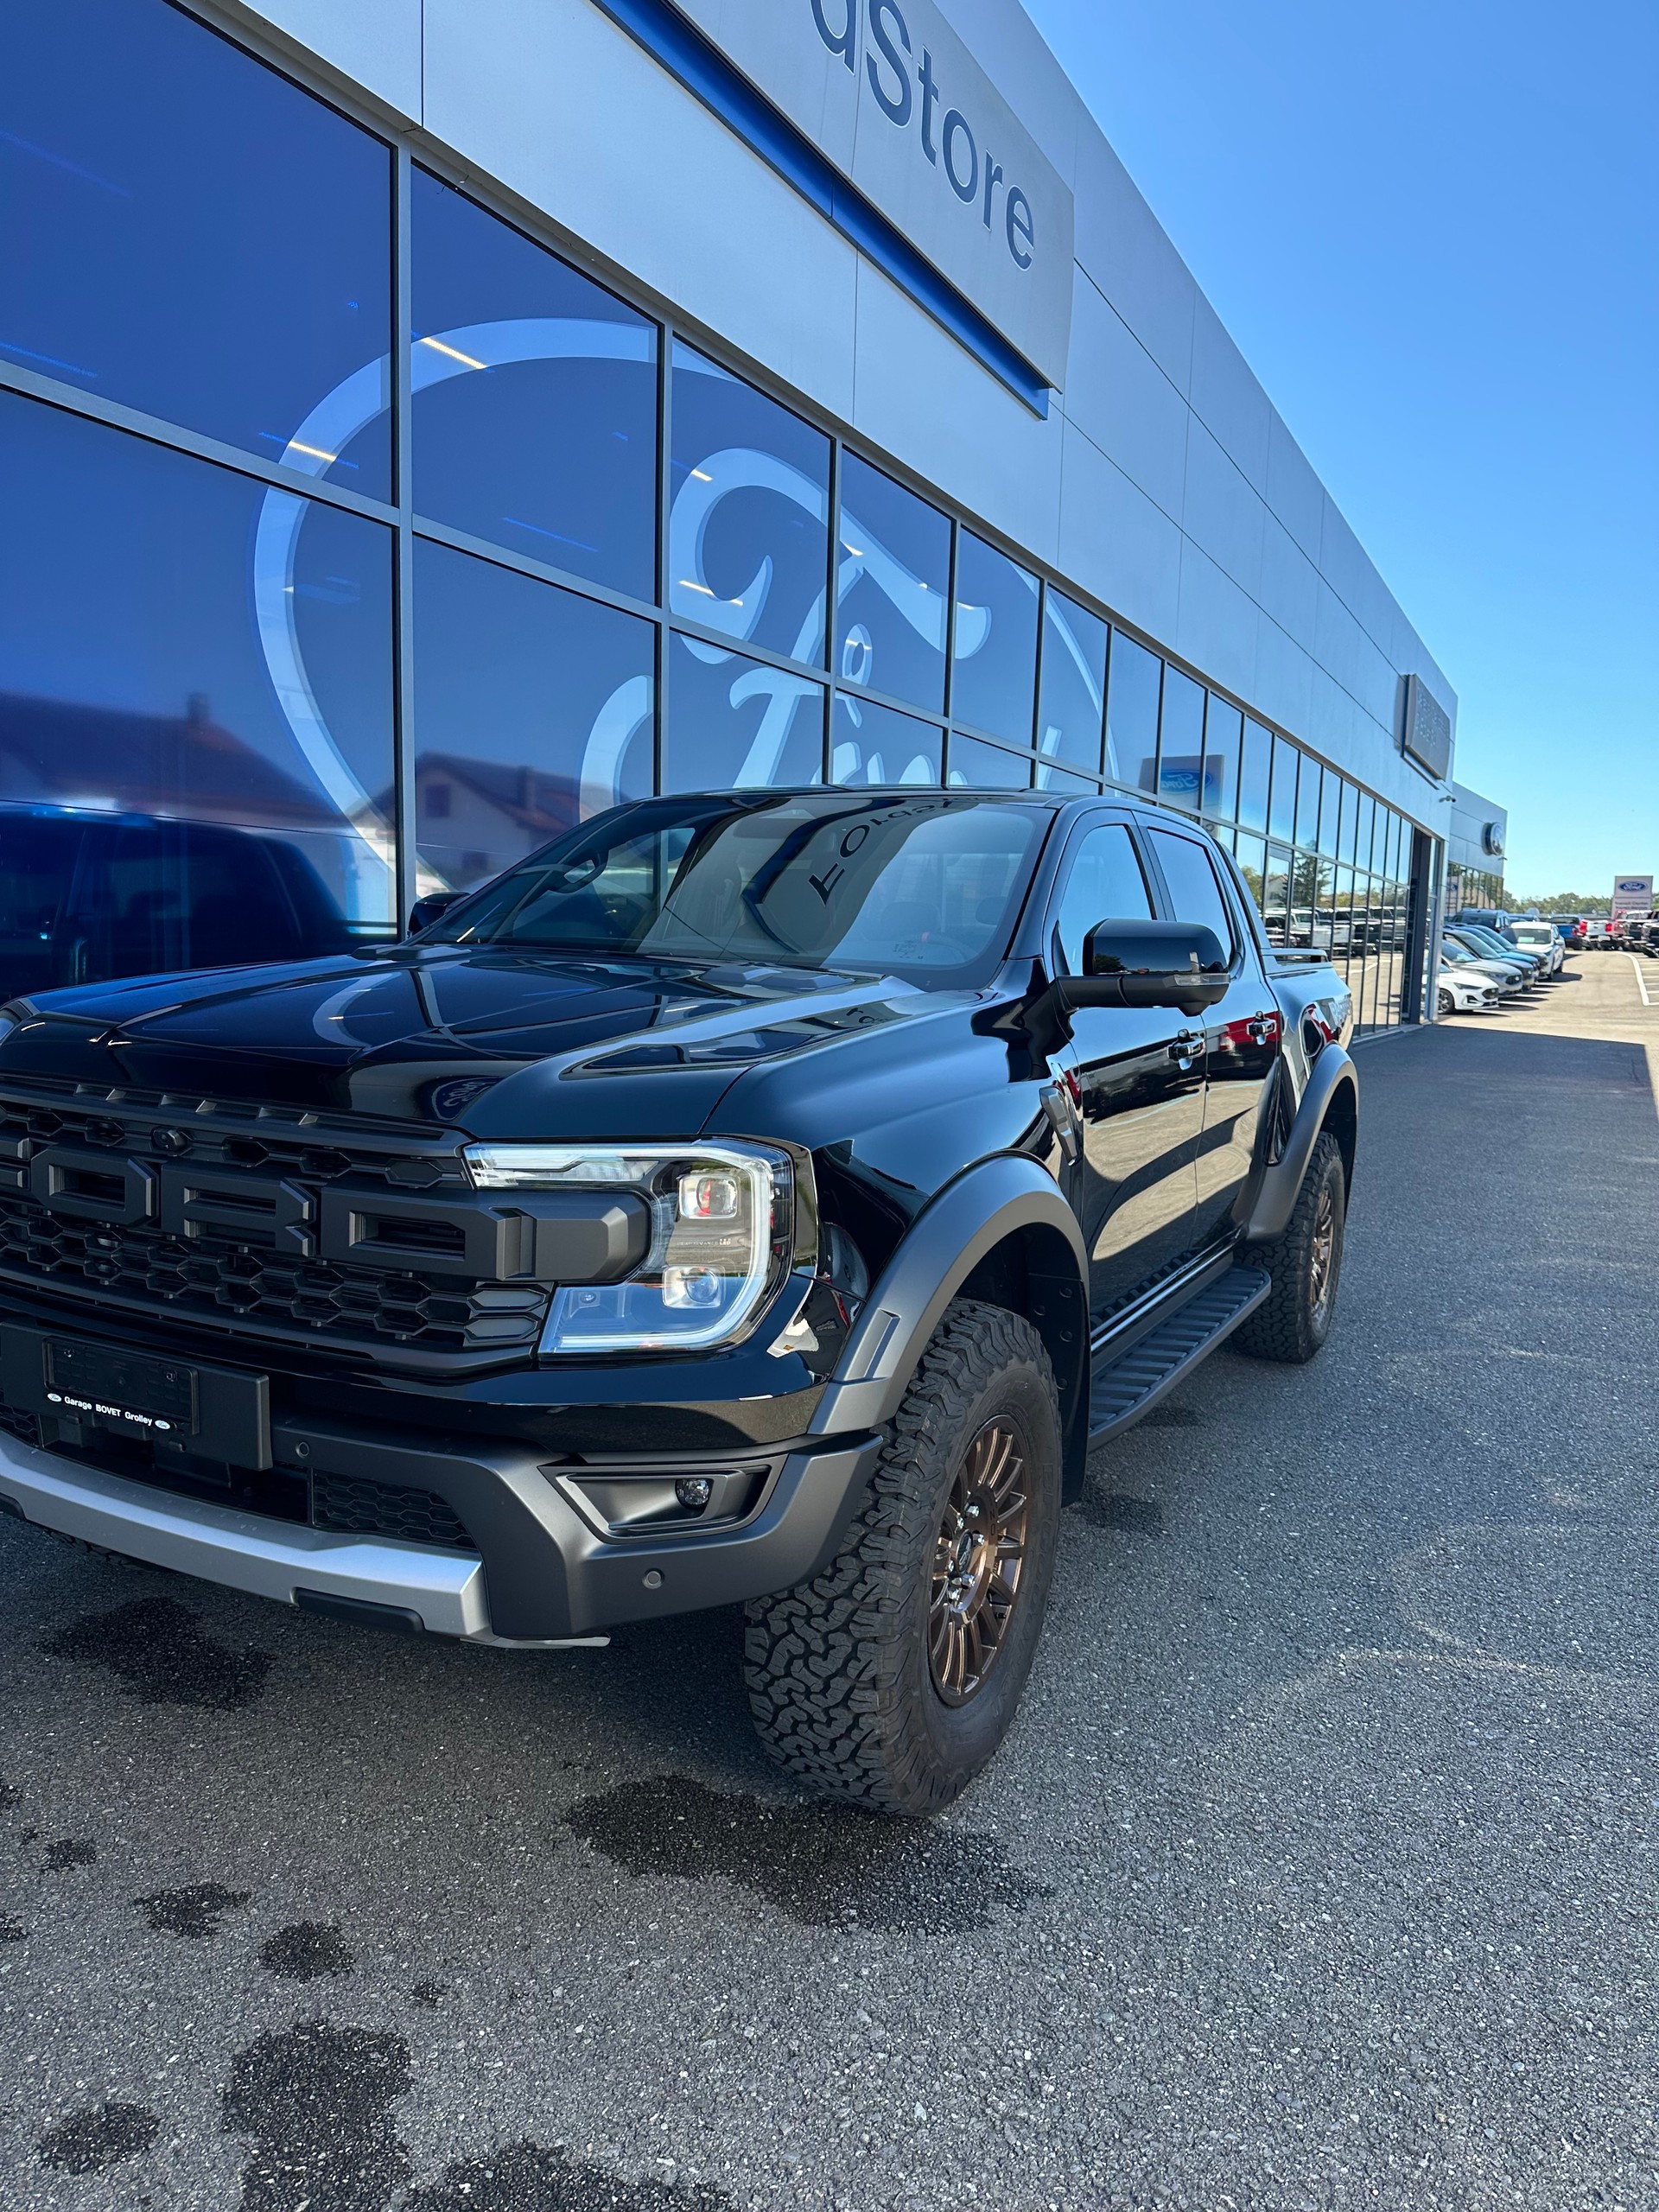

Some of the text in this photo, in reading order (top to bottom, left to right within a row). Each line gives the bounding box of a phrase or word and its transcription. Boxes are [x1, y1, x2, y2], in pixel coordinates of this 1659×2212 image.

[64, 1395, 92, 1410] Garage
[95, 1403, 121, 1417] BOVET
[124, 1411, 153, 1427] Grolley
